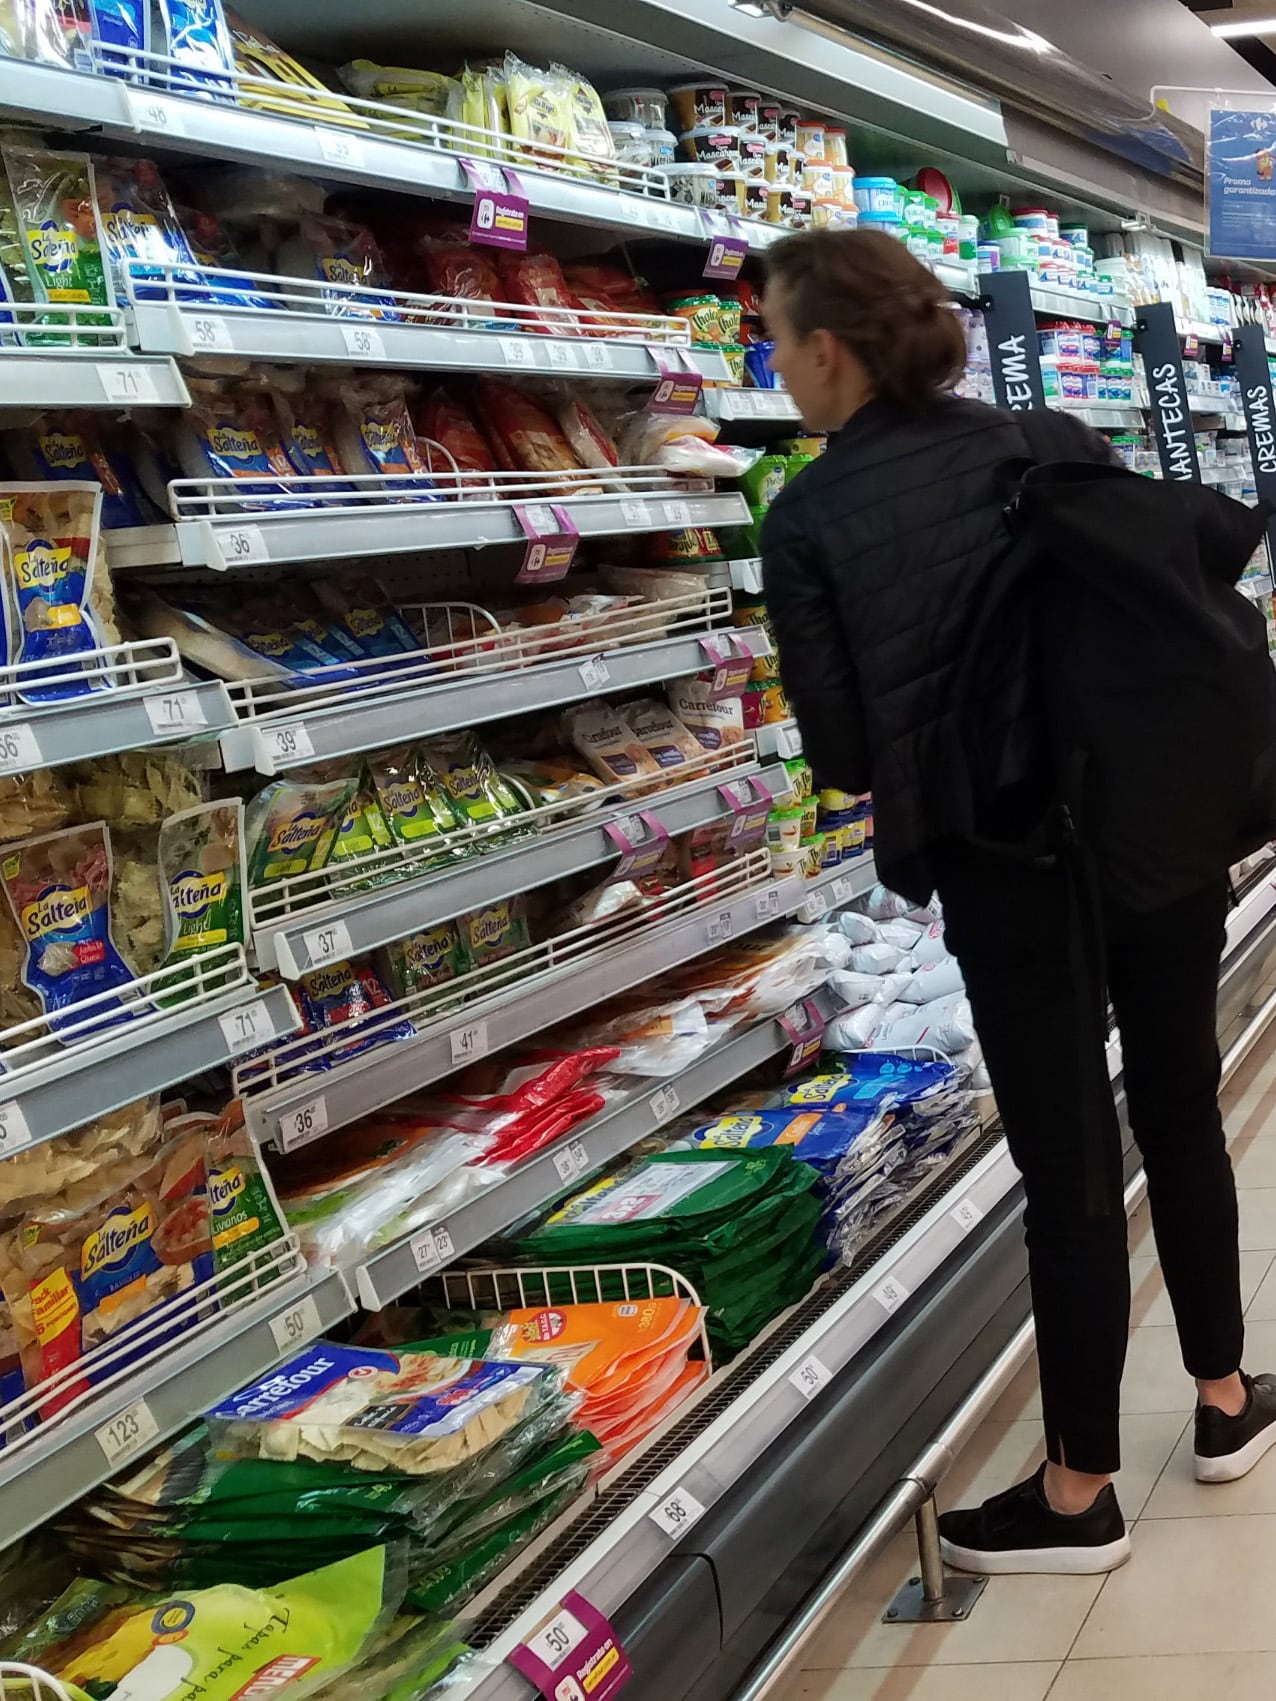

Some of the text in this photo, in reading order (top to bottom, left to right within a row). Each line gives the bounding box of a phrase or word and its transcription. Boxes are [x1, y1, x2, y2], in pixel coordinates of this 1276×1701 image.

[1223, 176, 1252, 186] Promo
[1223, 187, 1276, 197] garantizada
[45, 275, 73, 289] Light
[195, 321, 216, 343] 58
[354, 331, 371, 351] 58
[116, 371, 139, 393] 71
[1153, 362, 1193, 481] ANTECAS
[212, 434, 259, 452] Salteña
[230, 534, 251, 554] 36
[163, 698, 186, 721] 71
[680, 698, 734, 716] Carrefour
[277, 732, 297, 752] 39
[38, 900, 50, 912] La
[183, 918, 211, 936] Light
[318, 931, 336, 953] 37
[309, 967, 352, 997] Salteña
[364, 978, 380, 995] 12
[235, 1015, 256, 1037] 71
[459, 1033, 474, 1051] 41
[295, 1110, 313, 1133] 36
[209, 1176, 242, 1204] lteña
[83, 1214, 150, 1274] Salteña
[417, 1235, 450, 1261] 27 23
[884, 1284, 899, 1302] 49
[284, 1315, 304, 1338] 50
[801, 1367, 820, 1386] 50
[108, 1413, 140, 1447] 123
[664, 1501, 688, 1523] 68
[548, 1627, 570, 1652] 50
[204, 1647, 243, 1684] para
